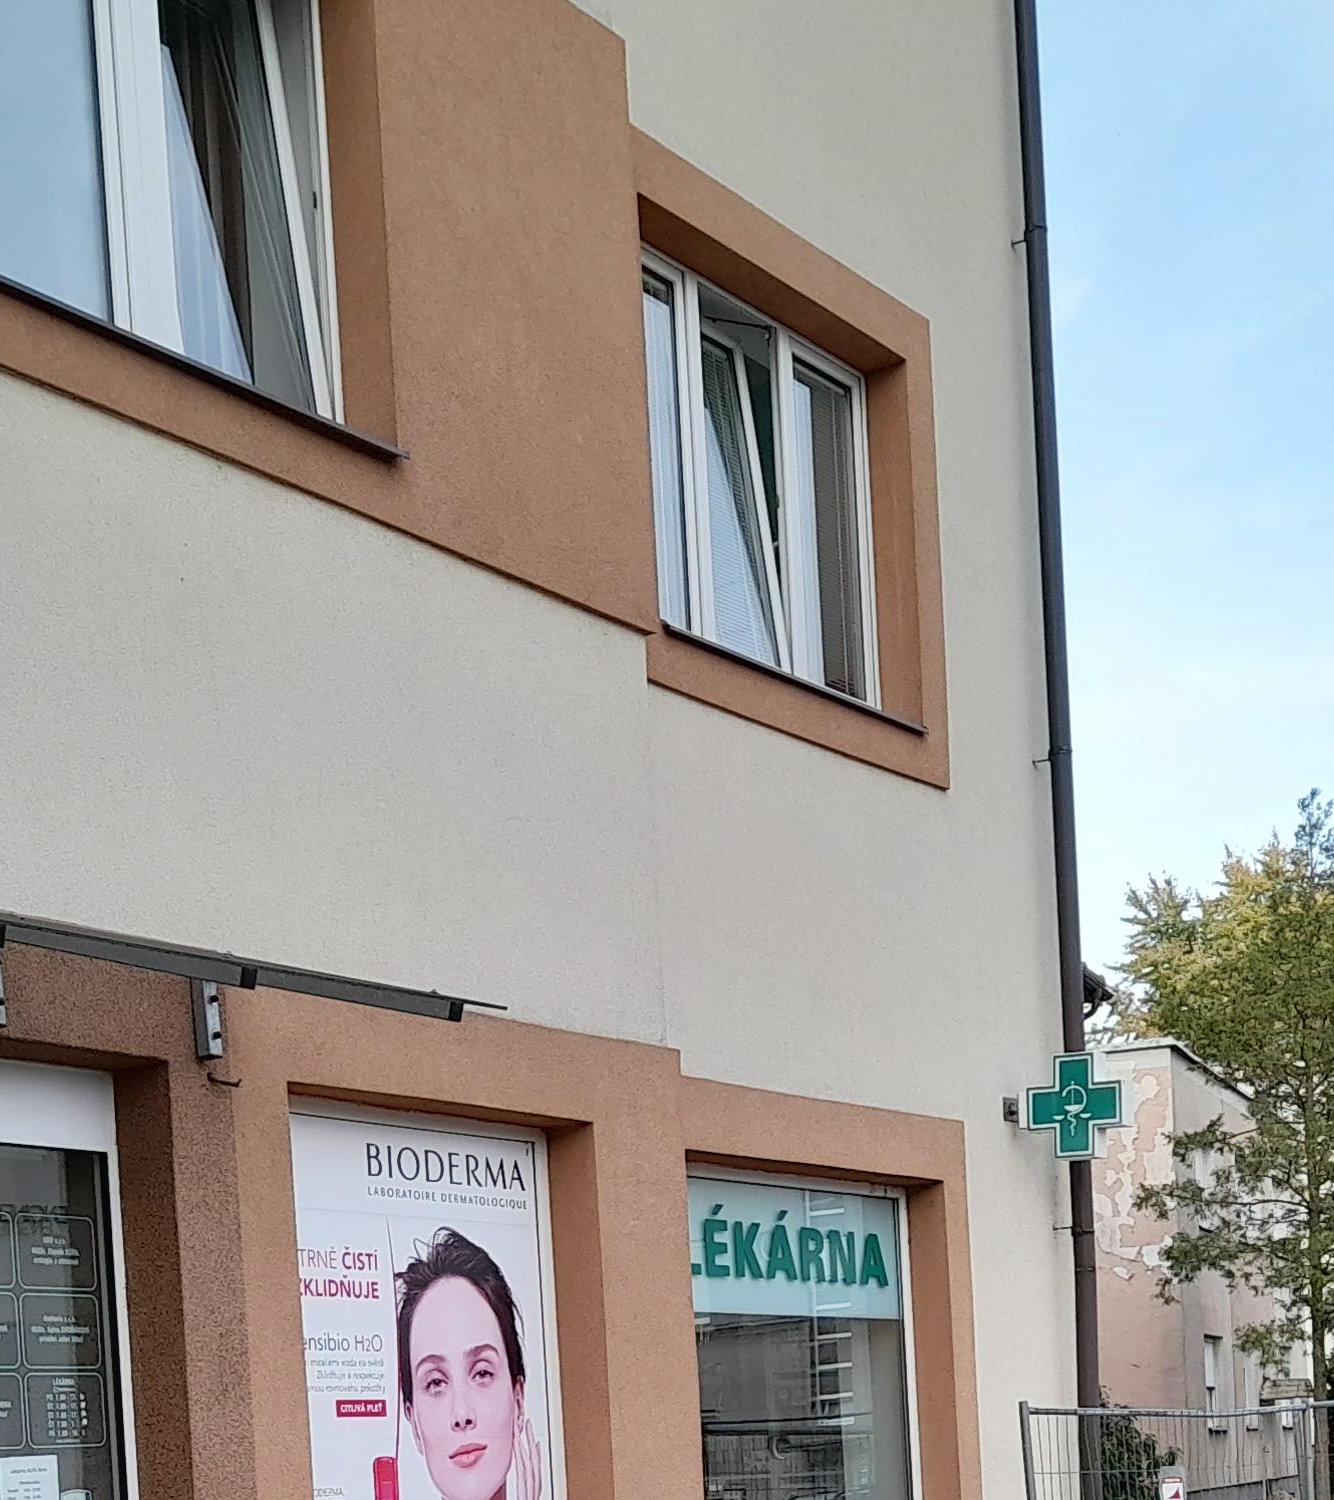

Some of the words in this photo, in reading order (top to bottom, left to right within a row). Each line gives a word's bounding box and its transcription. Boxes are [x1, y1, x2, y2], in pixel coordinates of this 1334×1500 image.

[365, 1142, 527, 1192] BIODERMA
[367, 1185, 436, 1202] LABORATOIRE
[440, 1192, 528, 1210] DERMATOLOGIQUE
[342, 1246, 378, 1271] ČISTÍ
[354, 1334, 383, 1352] H2O
